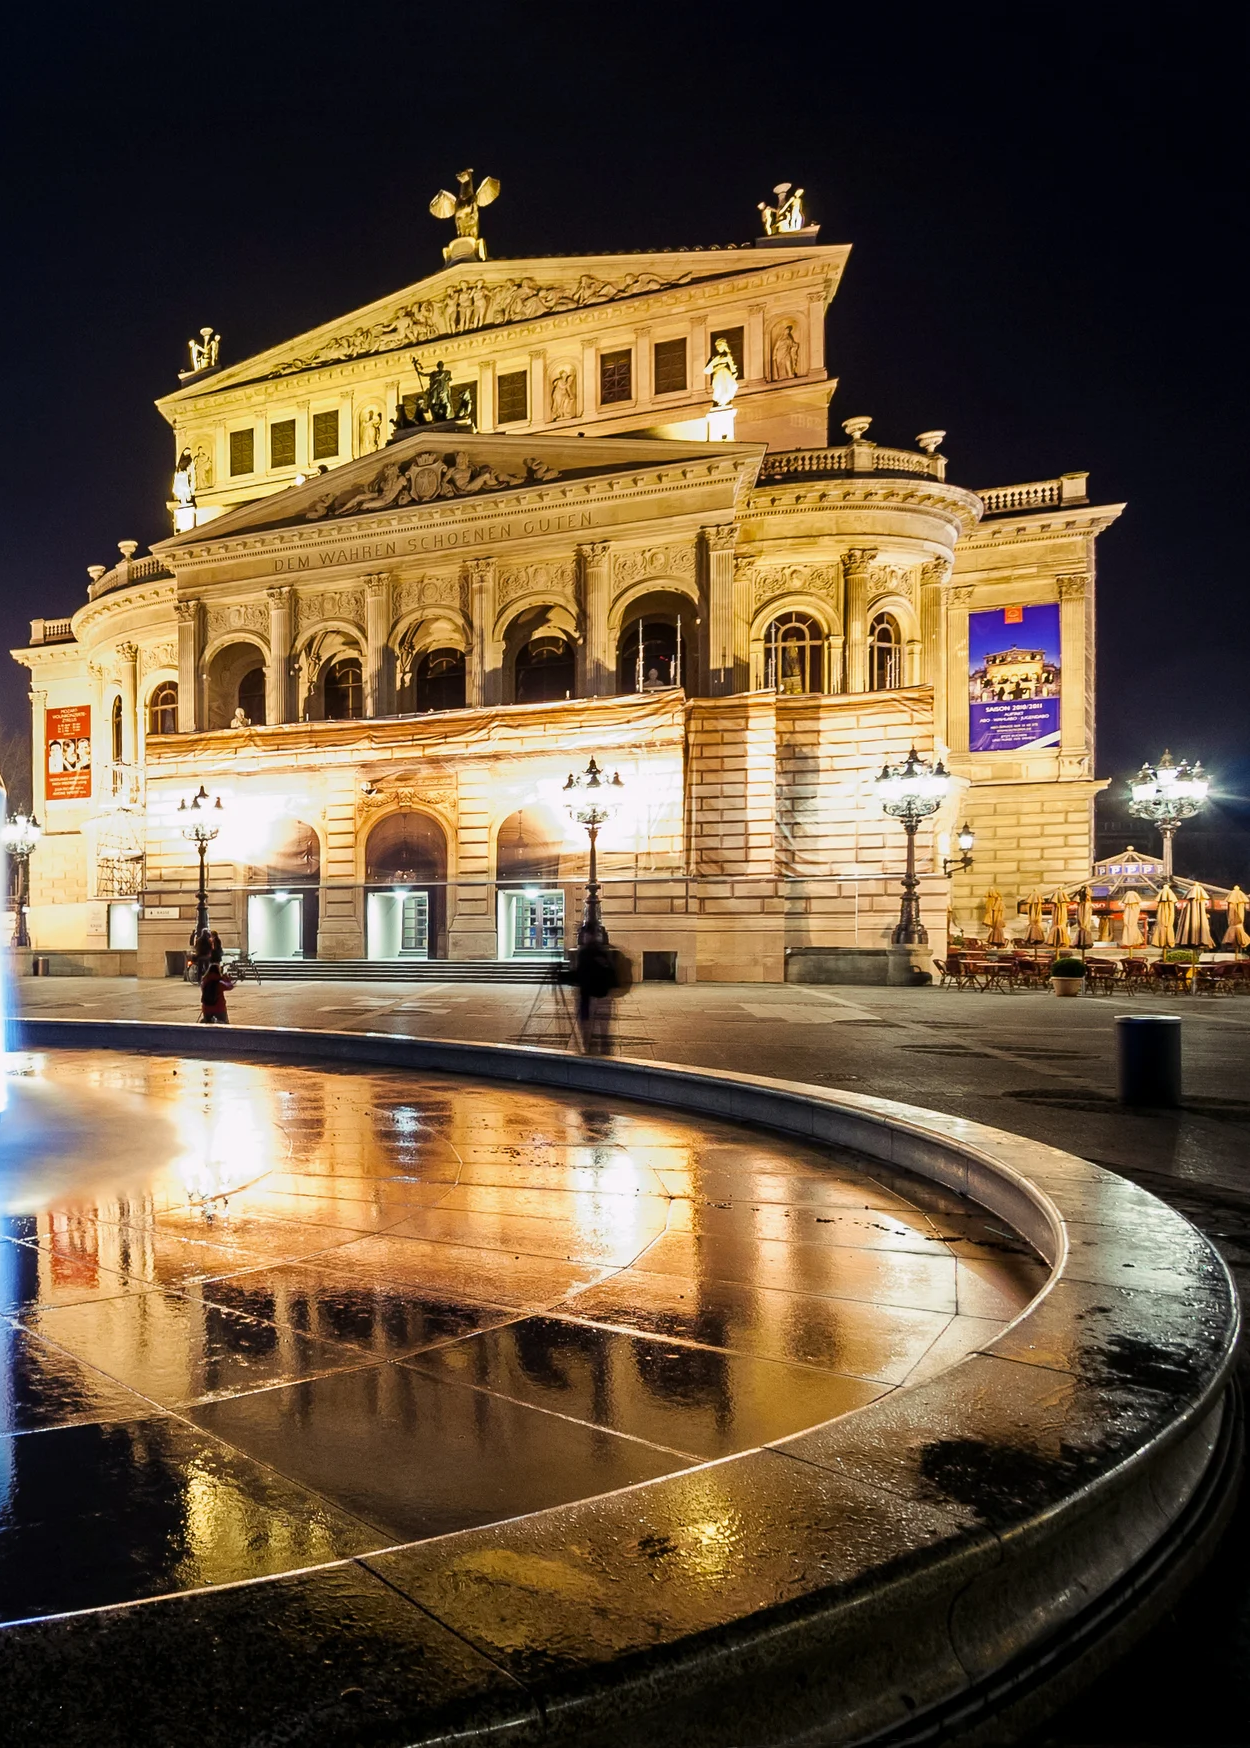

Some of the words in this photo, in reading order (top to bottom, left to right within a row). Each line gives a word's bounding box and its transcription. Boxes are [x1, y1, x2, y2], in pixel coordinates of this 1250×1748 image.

[274, 555, 310, 572] DEM
[319, 541, 396, 565] WAHREN
[407, 523, 511, 552] SCHOENEN
[1012, 703, 1043, 711] 2010/2011
